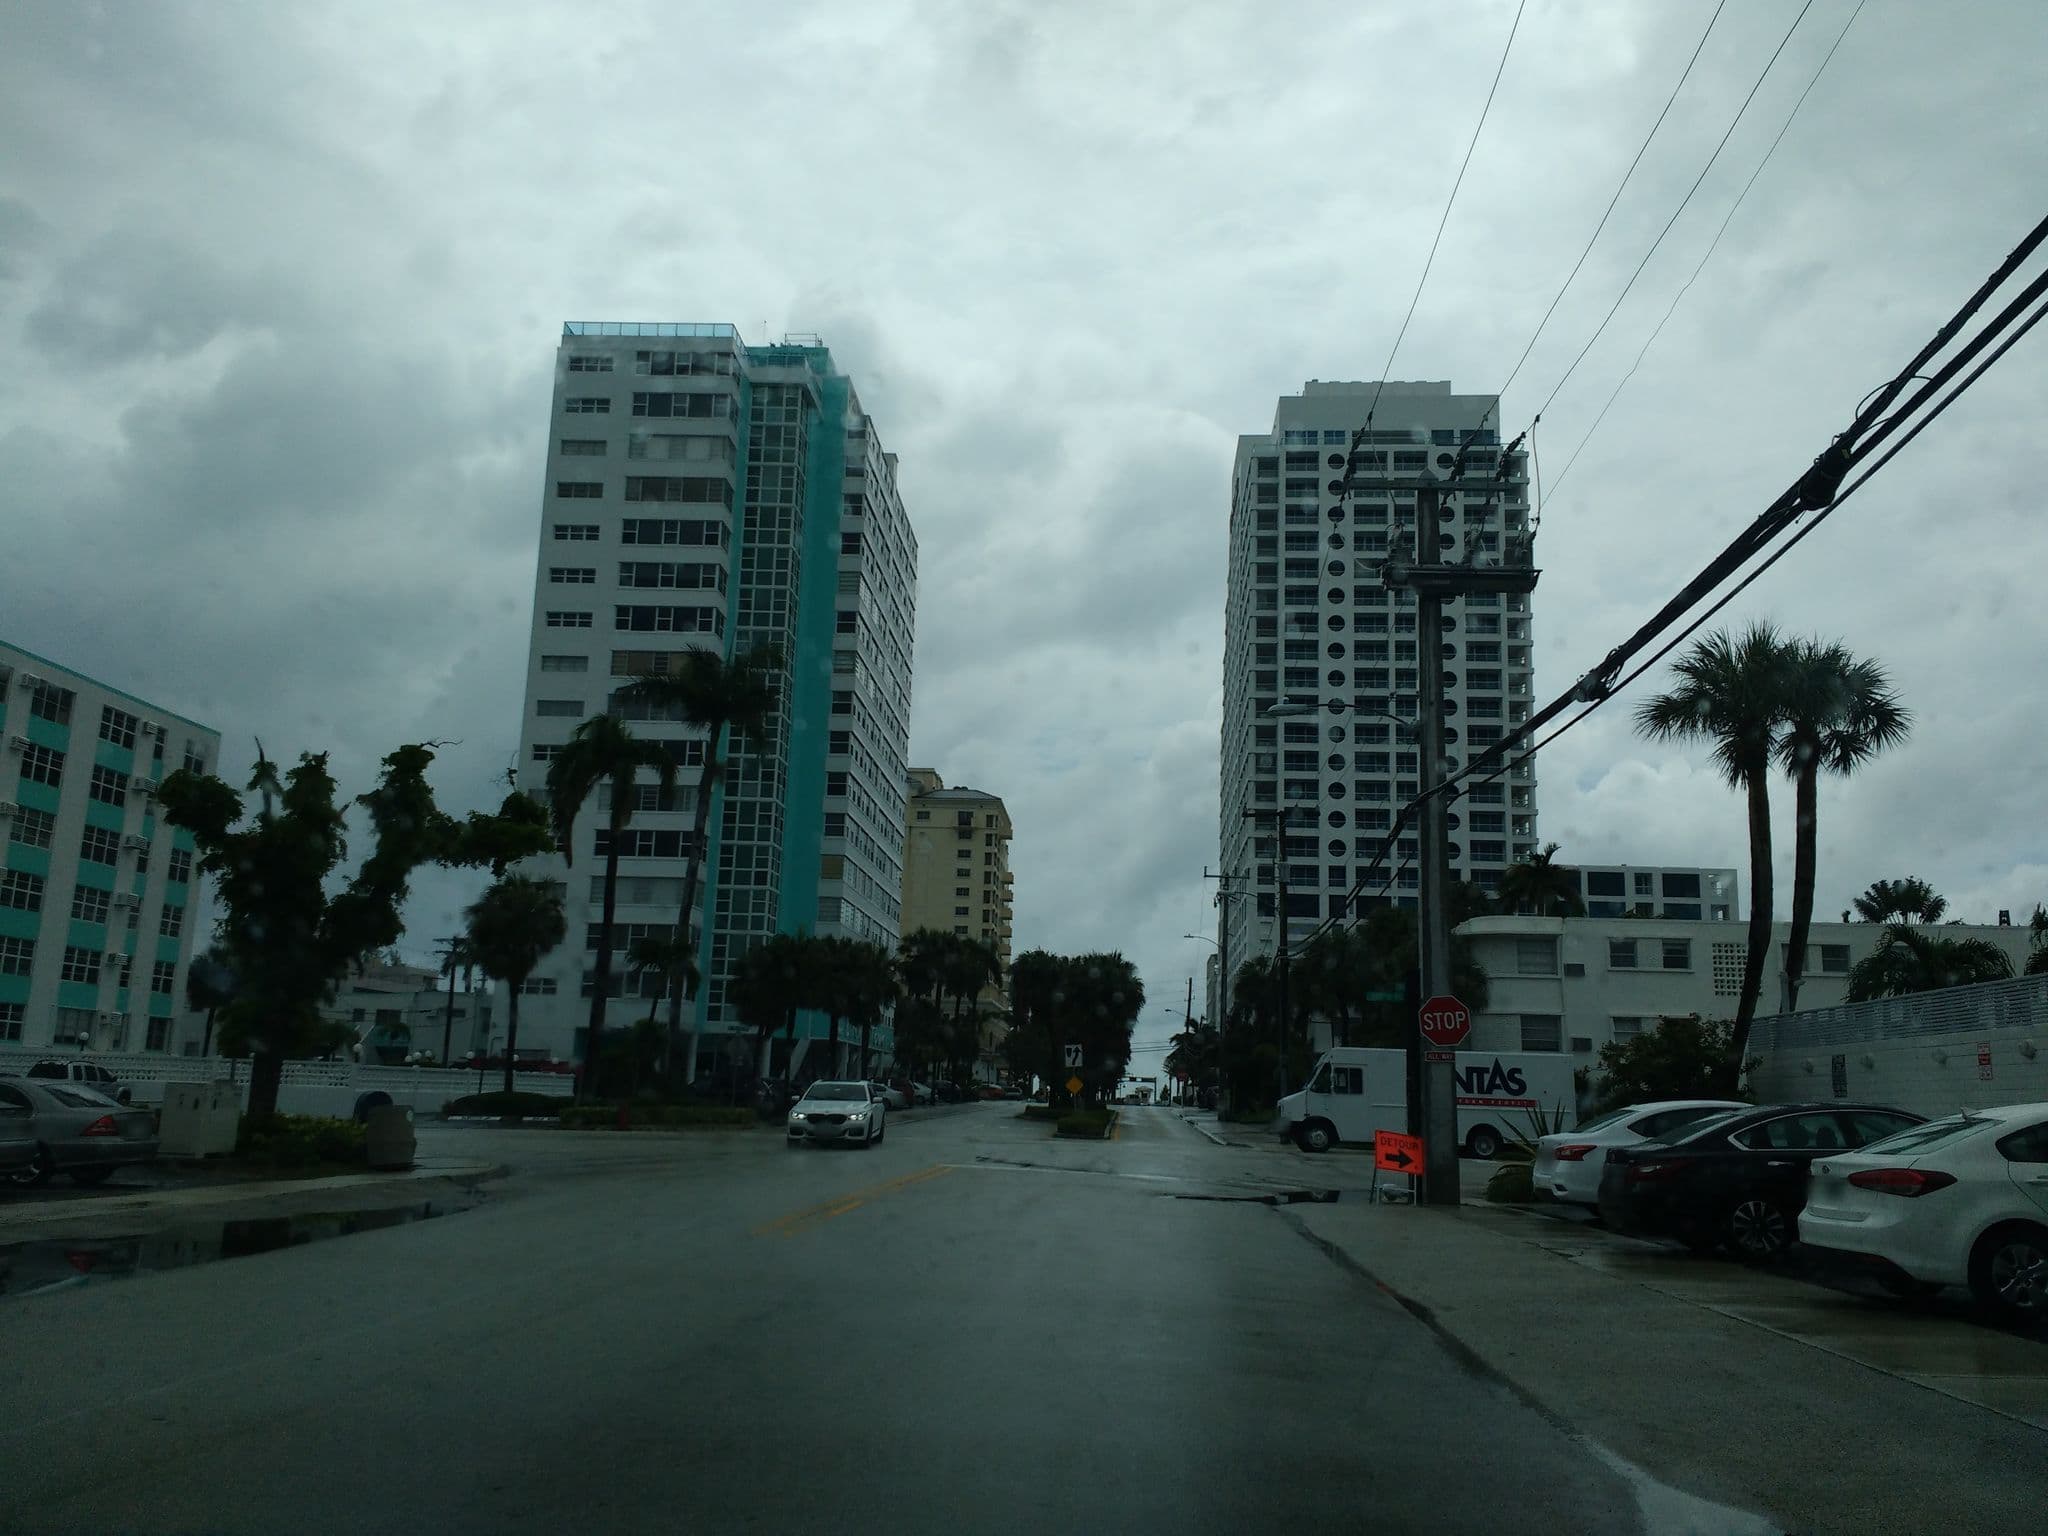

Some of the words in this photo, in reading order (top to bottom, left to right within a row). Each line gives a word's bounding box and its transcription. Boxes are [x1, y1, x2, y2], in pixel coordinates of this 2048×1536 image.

[1423, 1011, 1466, 1031] STOP
[1455, 1057, 1527, 1096] NTAS
[1380, 1135, 1418, 1151] DETOUR
